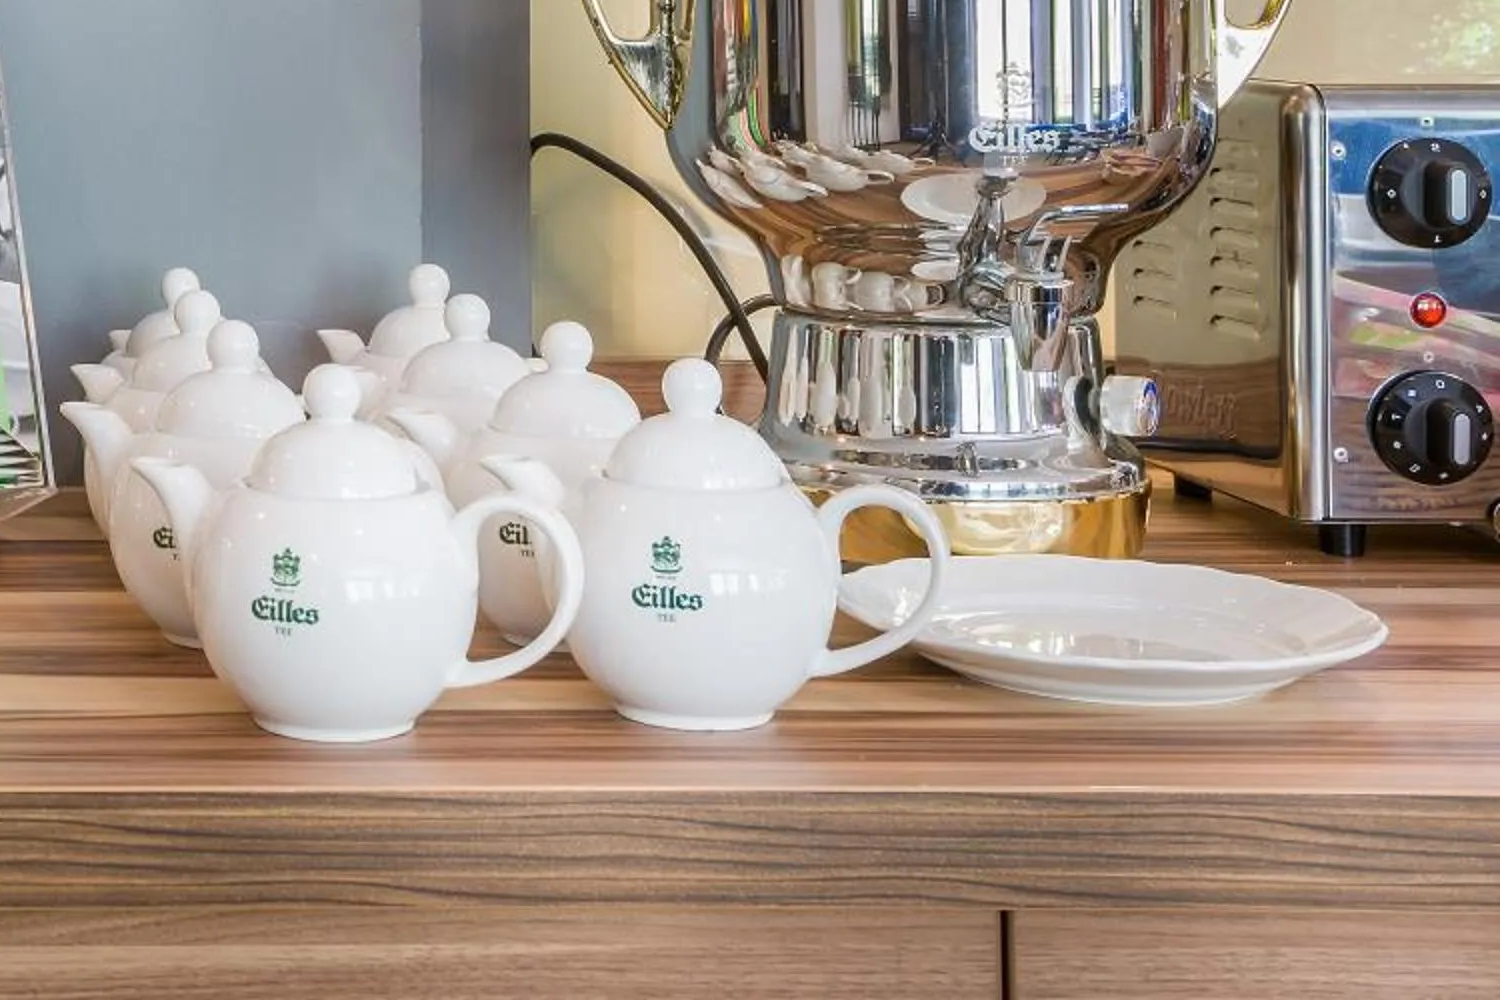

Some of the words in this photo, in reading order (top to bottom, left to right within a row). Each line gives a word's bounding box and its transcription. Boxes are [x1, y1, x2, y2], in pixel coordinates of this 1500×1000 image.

[968, 118, 1062, 154] Eilles
[499, 521, 533, 545] Eil
[251, 594, 320, 626] Eilles
[631, 582, 704, 612] Eilles
